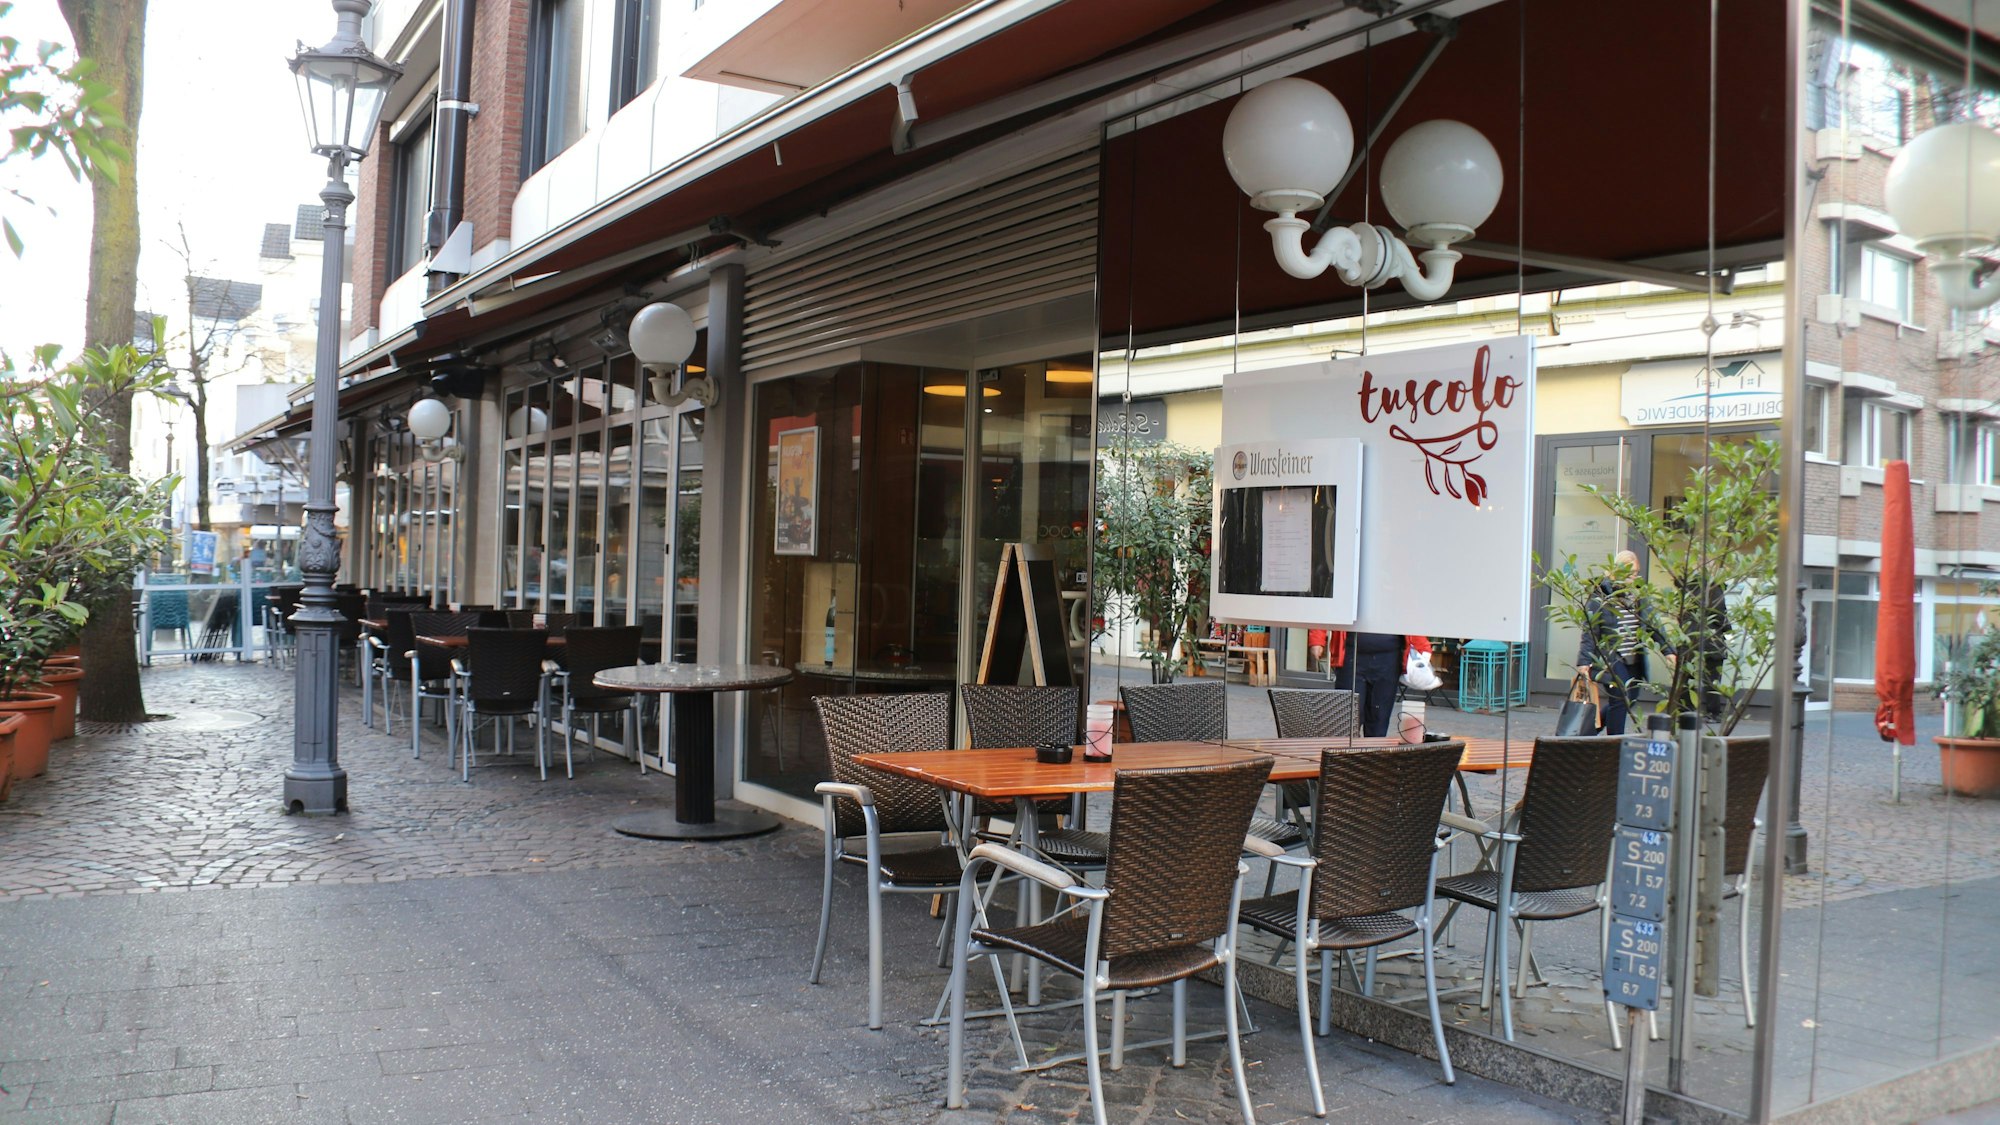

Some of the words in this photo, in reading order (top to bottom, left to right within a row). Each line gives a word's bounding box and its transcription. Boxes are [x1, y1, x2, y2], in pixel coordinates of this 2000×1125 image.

[1357, 344, 1524, 424] tuscolo
[1250, 448, 1313, 478] Warsteiner
[1648, 743, 1667, 757] 432
[1633, 751, 1647, 771] S
[1648, 760, 1671, 774] 200
[1652, 785, 1669, 799] 7.0
[1635, 804, 1653, 818] 7.3
[1642, 831, 1660, 846] 434
[1628, 841, 1641, 860] S
[1643, 850, 1665, 865] 200
[1645, 874, 1663, 889] 5.7
[1629, 893, 1647, 909] 7.2
[1635, 921, 1654, 936] 433
[1621, 929, 1634, 948] S
[1637, 939, 1658, 955] 200
[1638, 964, 1657, 980] 6.2
[1622, 982, 1640, 997] 6.7
